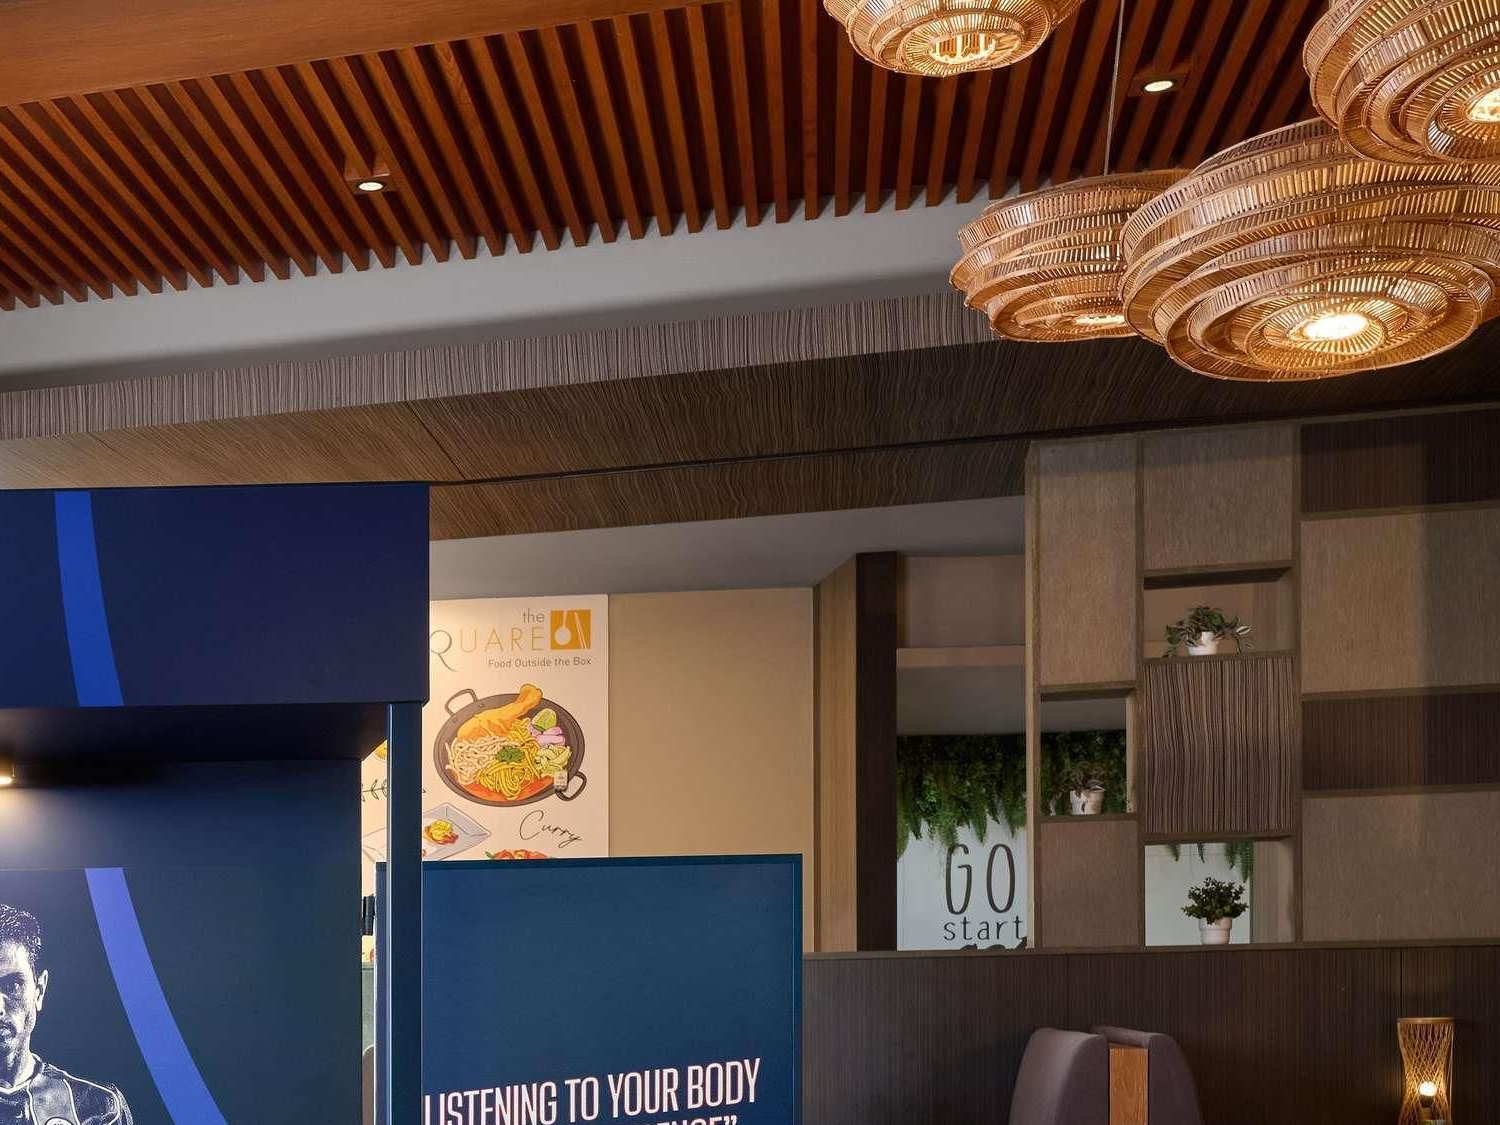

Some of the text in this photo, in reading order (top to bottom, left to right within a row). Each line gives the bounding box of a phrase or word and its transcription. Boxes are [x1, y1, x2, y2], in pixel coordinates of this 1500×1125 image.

[522, 607, 545, 623] the
[429, 626, 545, 672] QUARE
[488, 655, 592, 668] Food Outside the Box
[519, 809, 583, 848] Curry
[944, 843, 1016, 915] GO
[943, 915, 1023, 941] start
[564, 1076, 599, 1123] TO
[607, 1068, 679, 1118] YOUR
[687, 1057, 761, 1109] BODY
